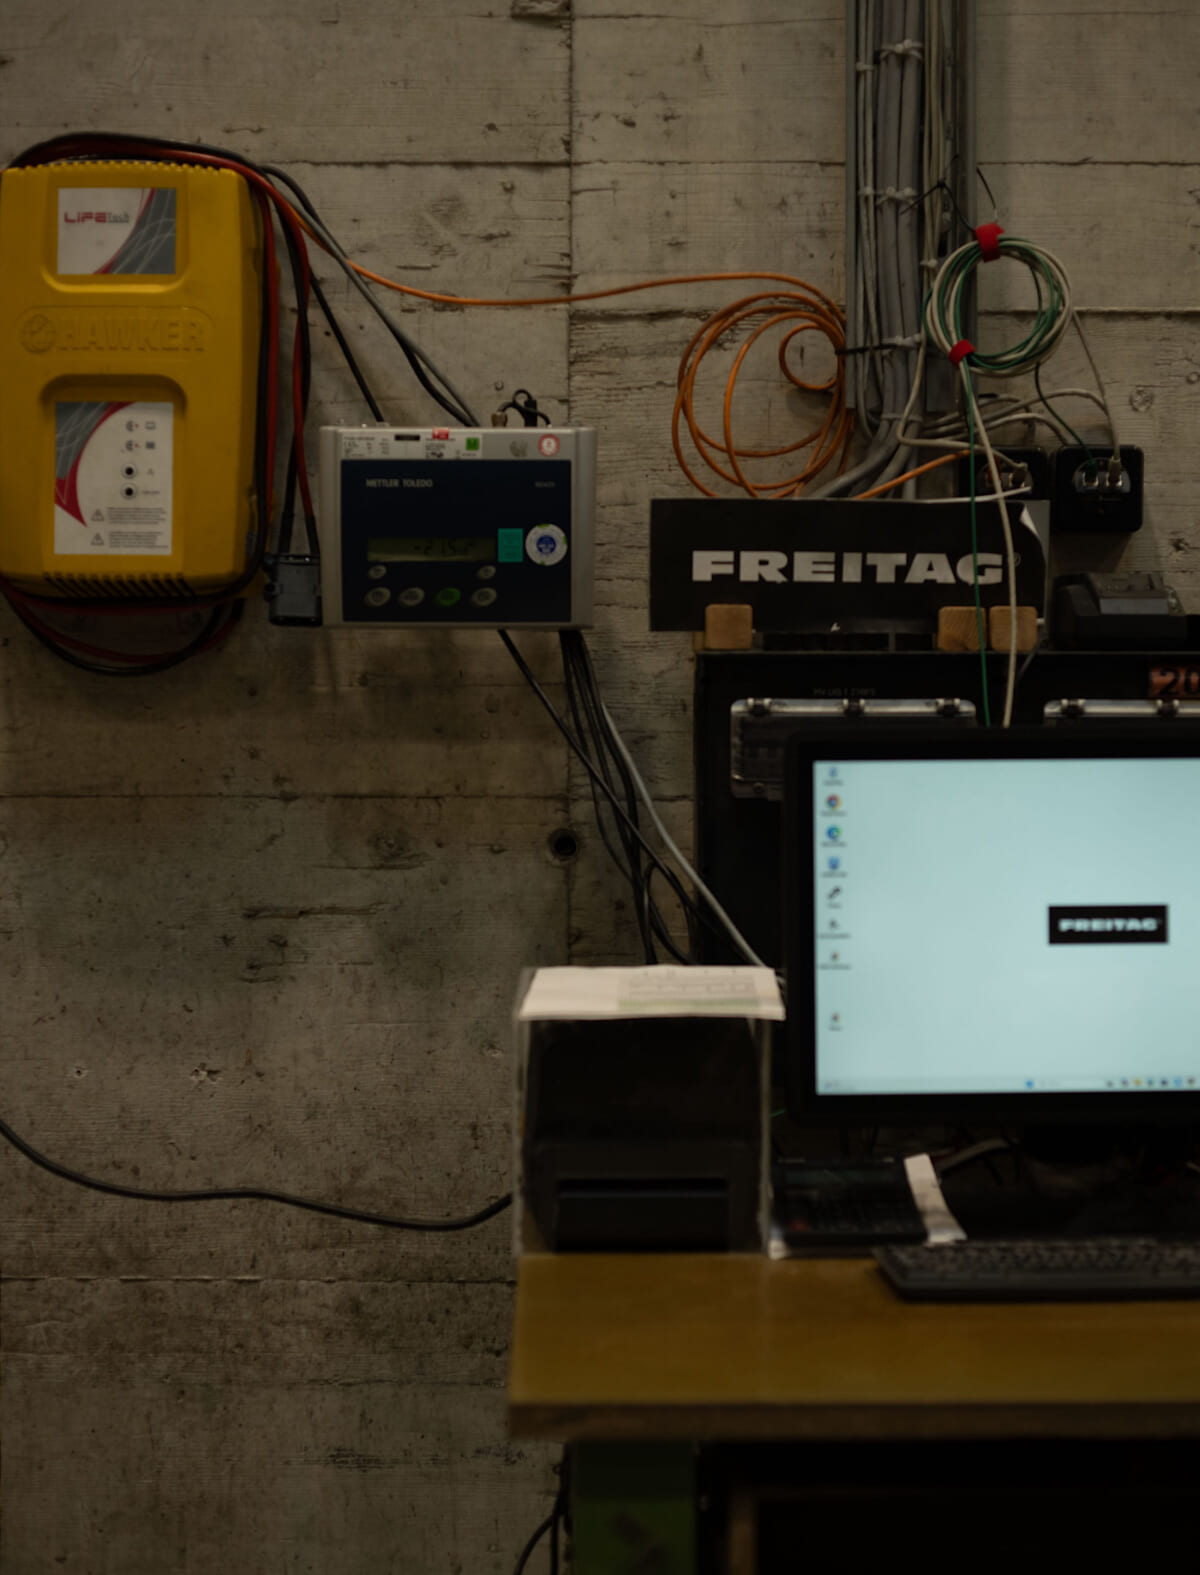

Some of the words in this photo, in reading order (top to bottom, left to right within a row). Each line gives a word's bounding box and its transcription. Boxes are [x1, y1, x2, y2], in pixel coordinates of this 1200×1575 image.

[58, 318, 206, 353] HAWKER
[366, 478, 399, 488] METTLER
[403, 478, 433, 488] TOLEDO
[692, 550, 1004, 586] FREITAG
[1058, 917, 1158, 933] FREITAG
